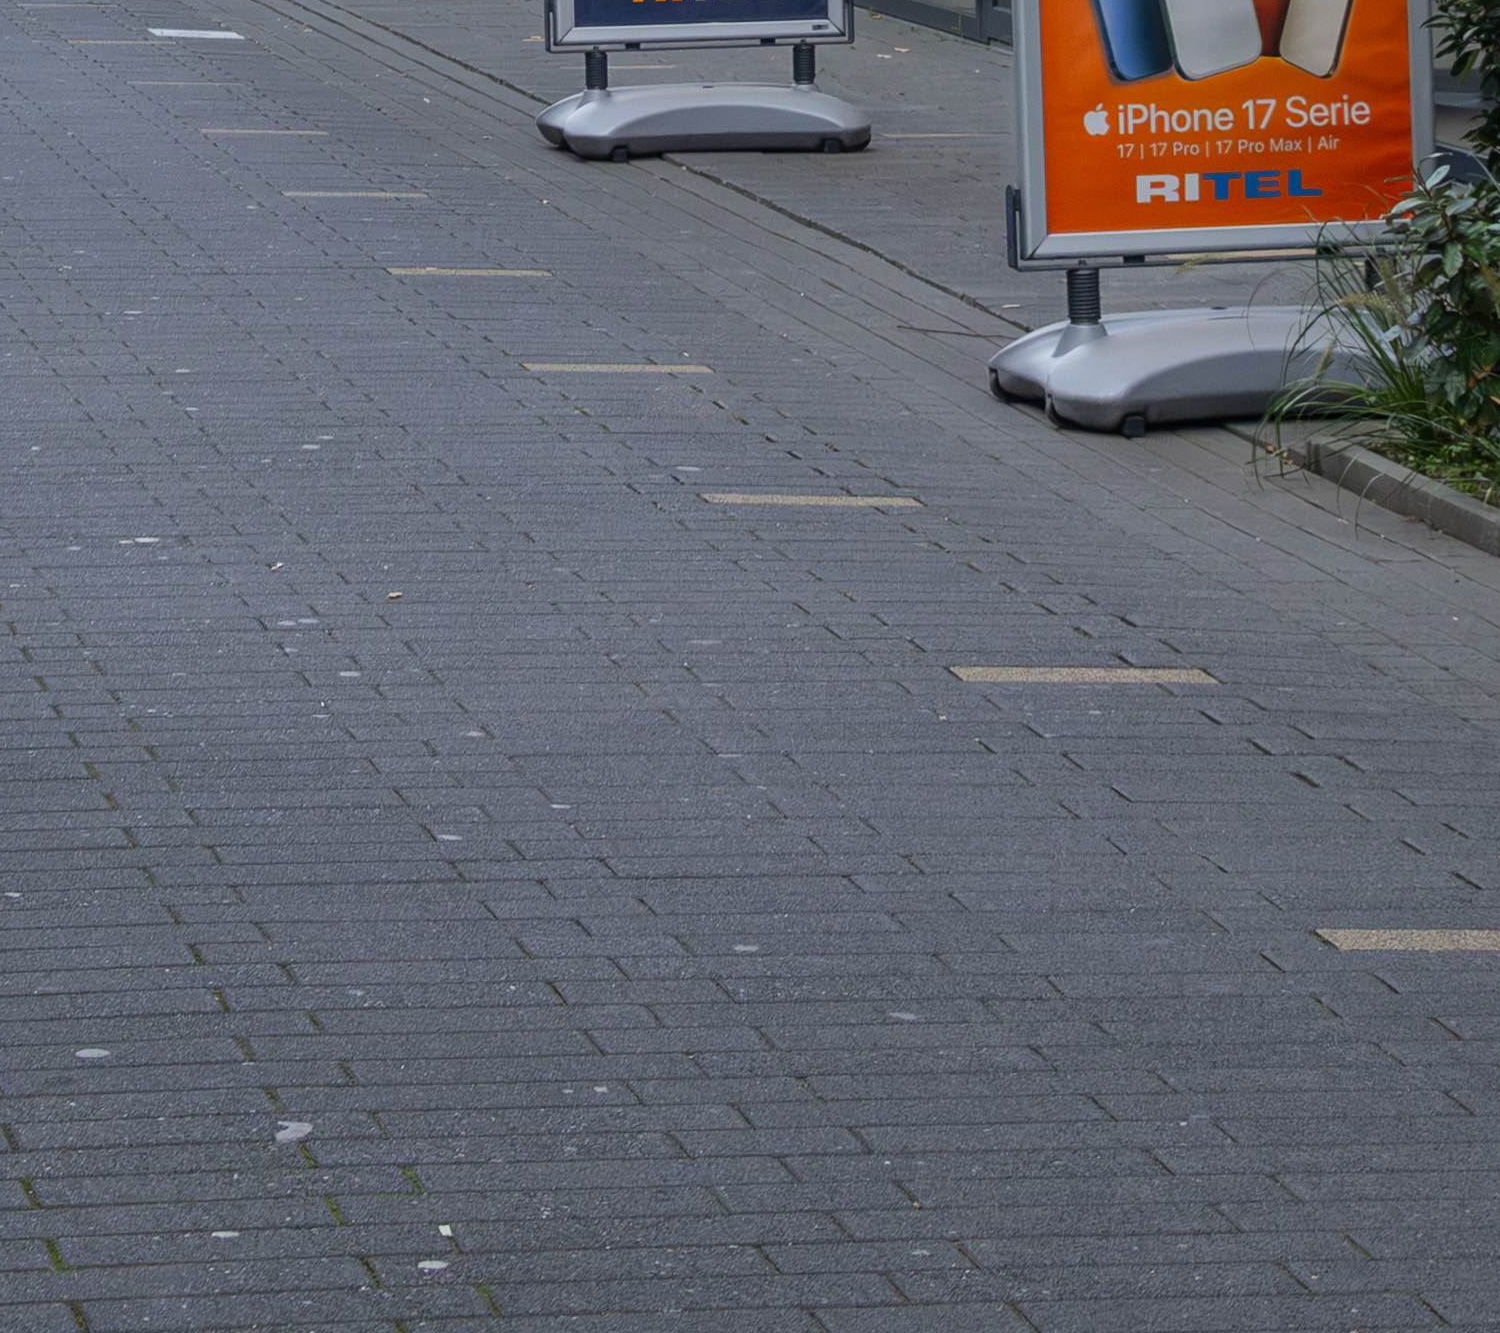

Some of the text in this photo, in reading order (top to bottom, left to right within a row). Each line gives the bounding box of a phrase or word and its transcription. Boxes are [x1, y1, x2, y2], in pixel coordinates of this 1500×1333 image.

[1117, 94, 1371, 135] iPhone 17 Serie
[1116, 135, 1340, 159] 17 17 Pro 17 Pro Max Air
[1135, 169, 1323, 204] RITEL
